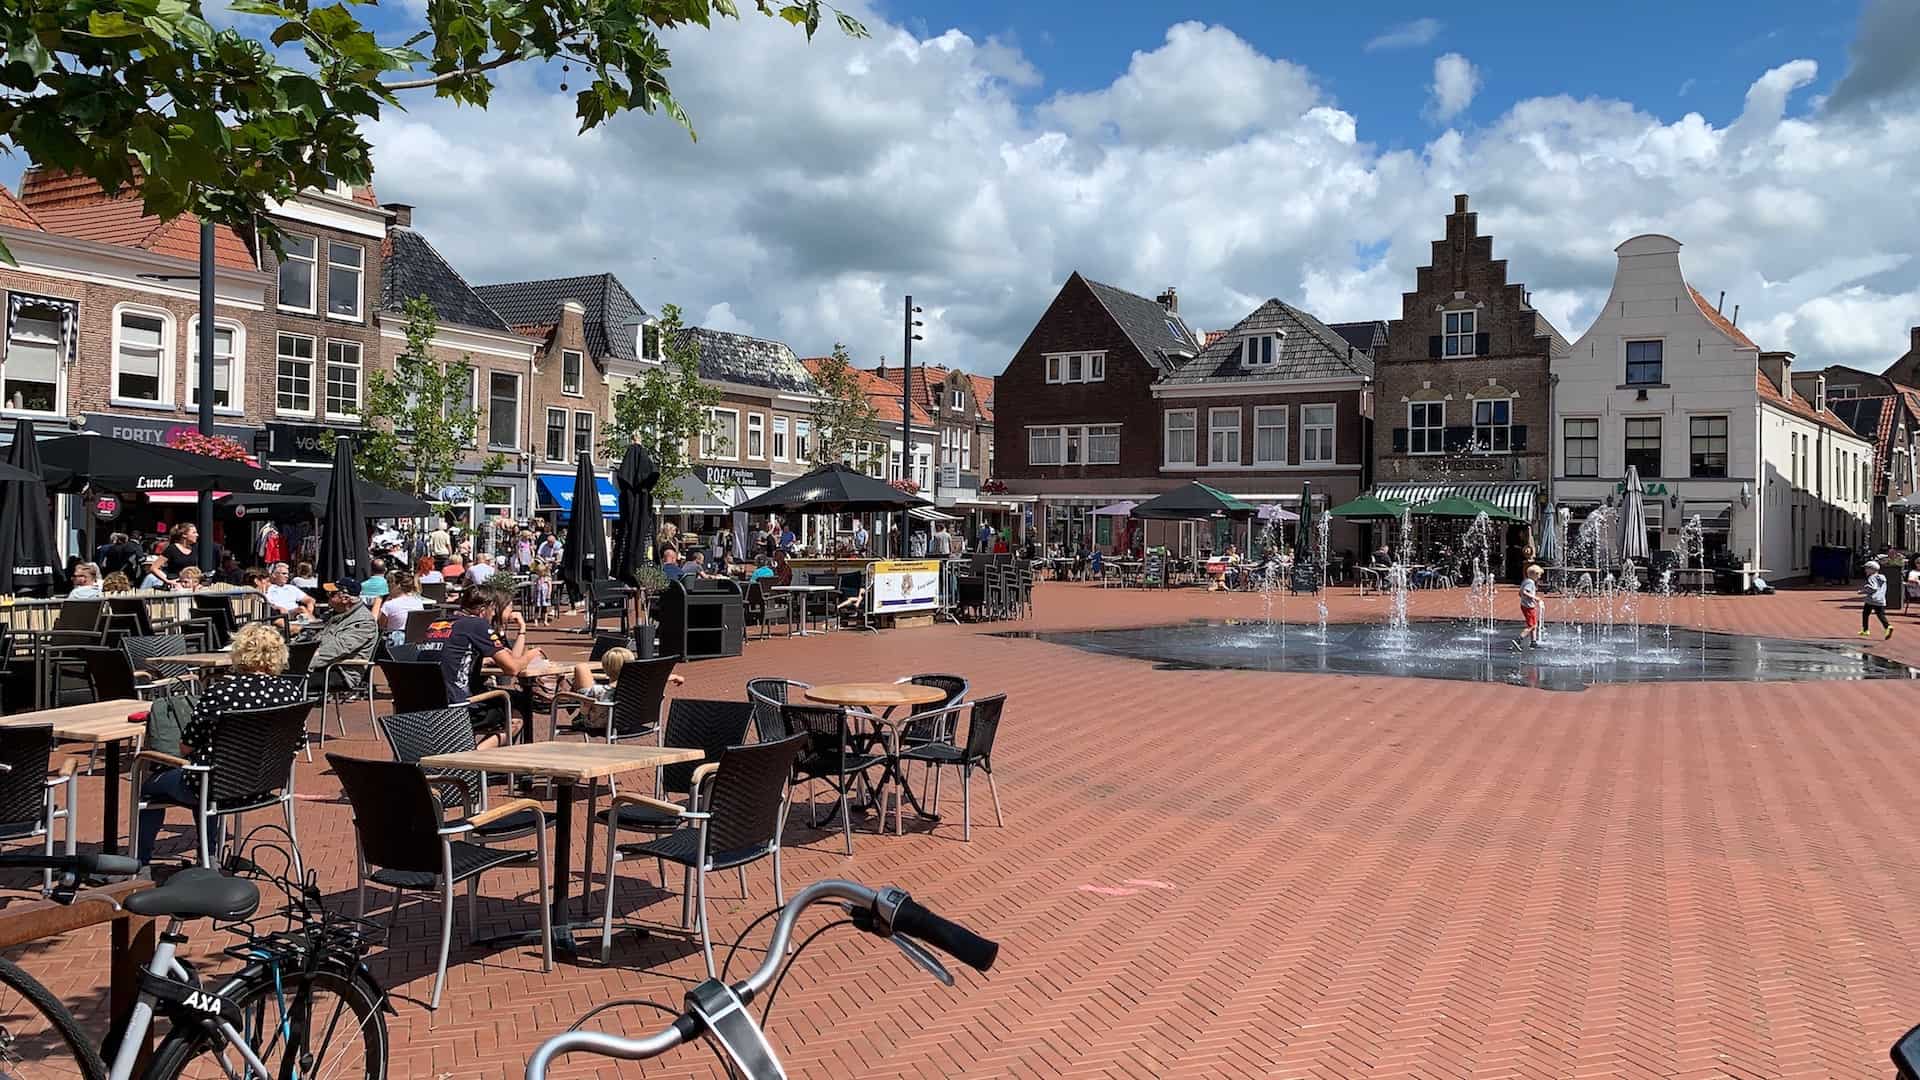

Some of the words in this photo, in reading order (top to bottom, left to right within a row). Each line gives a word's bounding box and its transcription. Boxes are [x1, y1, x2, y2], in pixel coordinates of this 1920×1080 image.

[112, 426, 164, 443] FORTY
[136, 475, 174, 489] Lunch
[253, 479, 282, 492] Diner
[182, 991, 221, 1016] AXA
